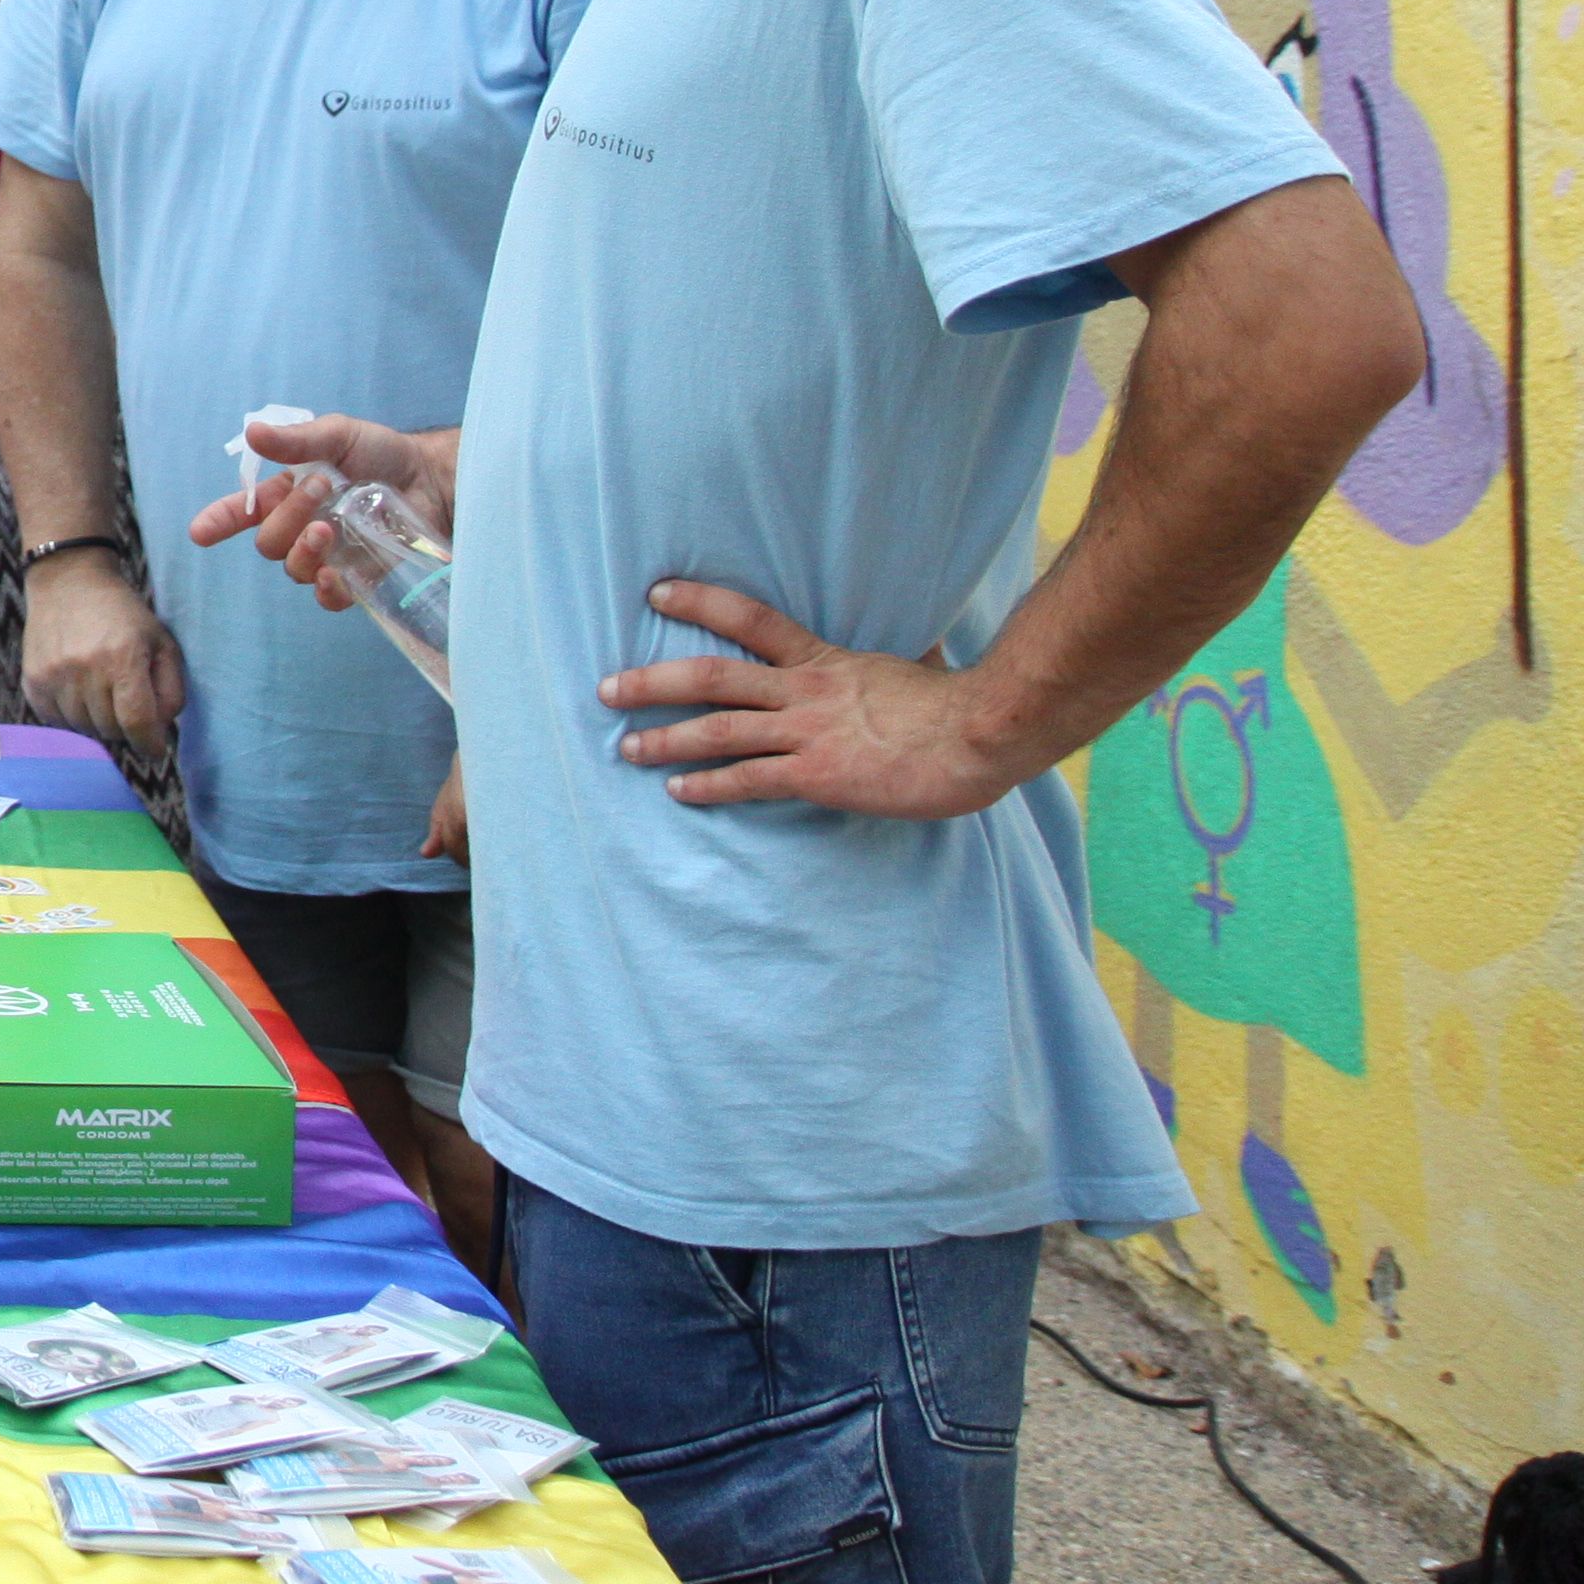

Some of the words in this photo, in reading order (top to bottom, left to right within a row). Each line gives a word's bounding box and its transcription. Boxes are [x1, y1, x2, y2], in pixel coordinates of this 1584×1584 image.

[350, 95, 452, 113] Gaispositius
[66, 993, 95, 1012] 144
[55, 1108, 173, 1127] MATRIX
[76, 1130, 151, 1140] CONDOMS
[515, 1428, 558, 1449] USA
